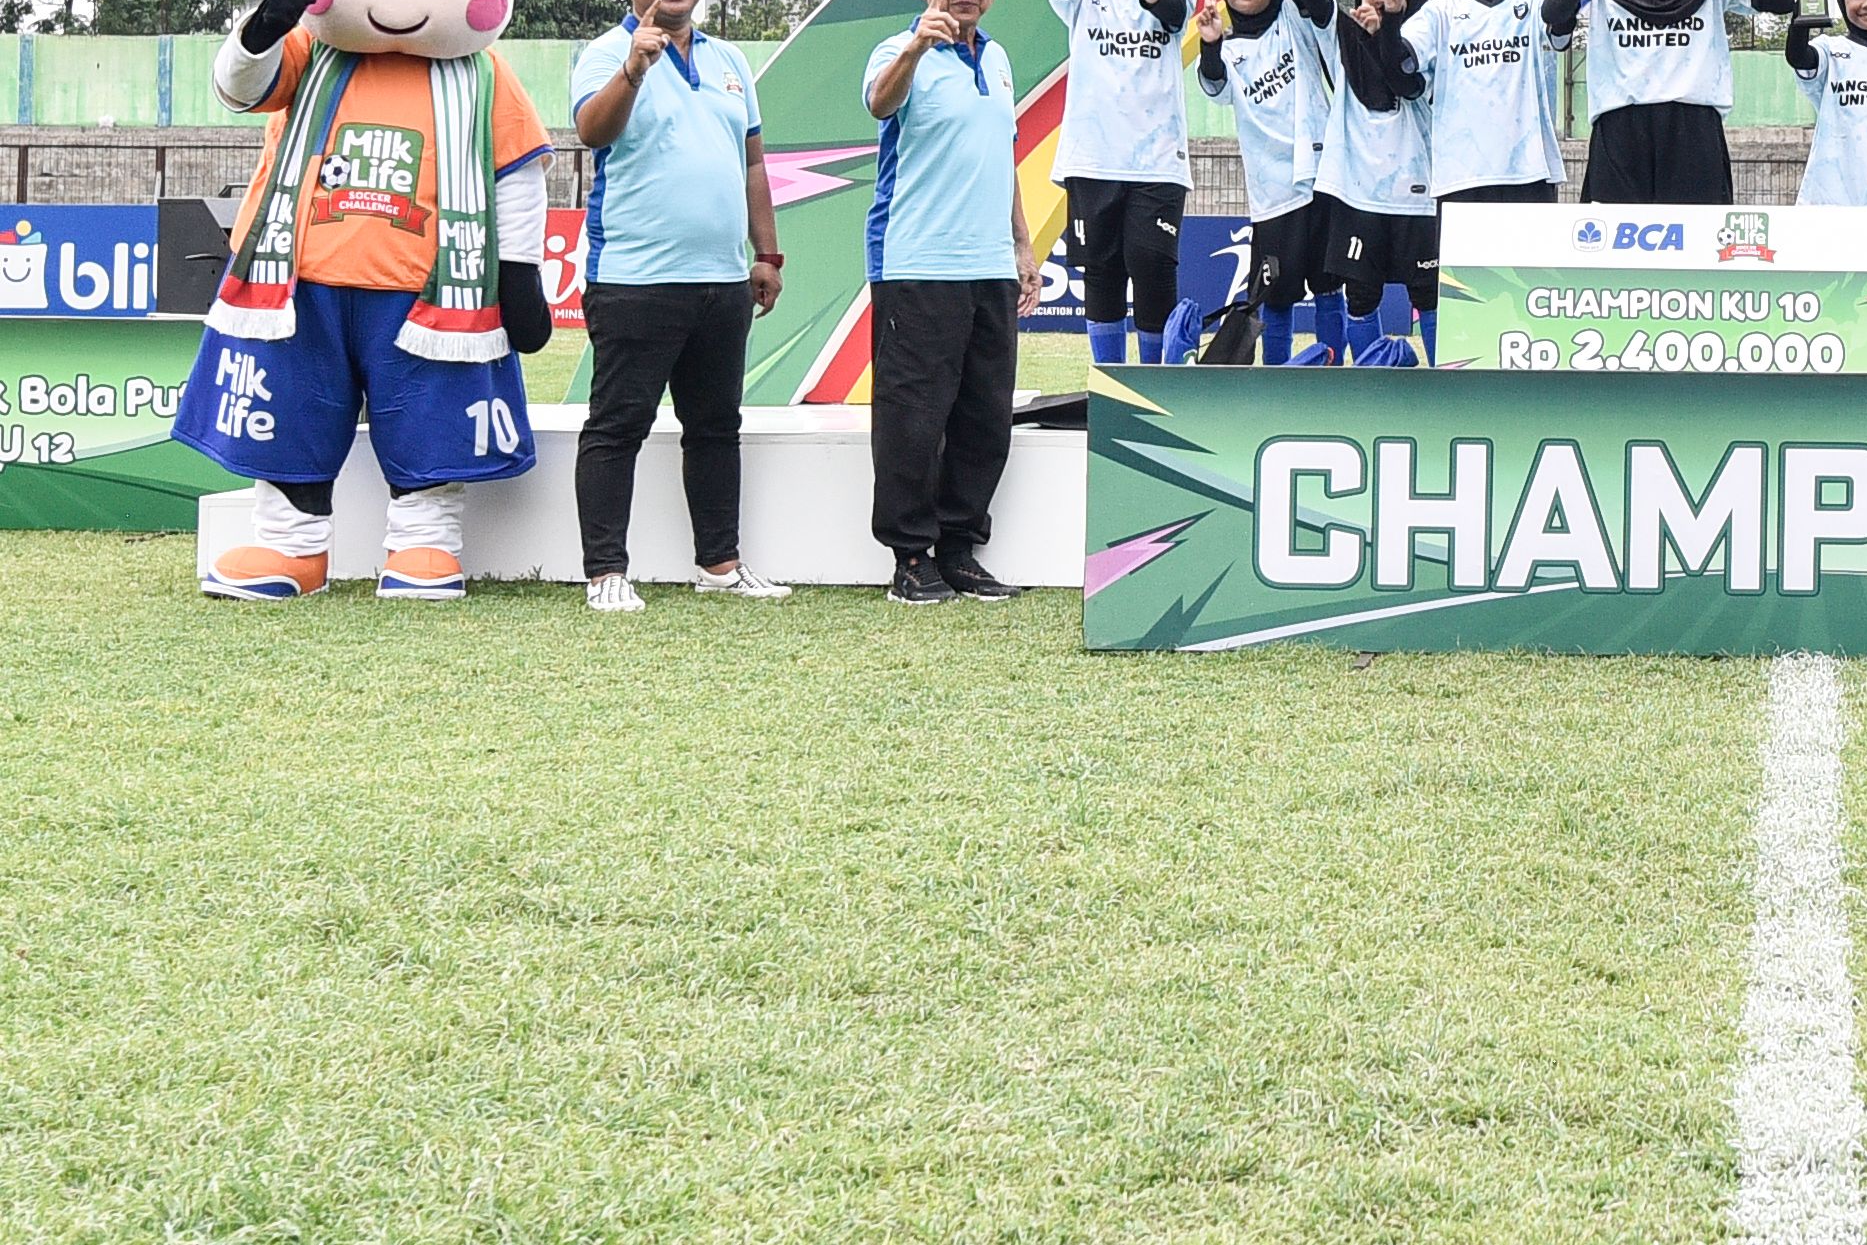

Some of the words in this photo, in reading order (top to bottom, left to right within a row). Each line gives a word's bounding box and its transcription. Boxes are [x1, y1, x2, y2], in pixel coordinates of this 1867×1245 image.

[1099, 42, 1162, 59] UNITED
[1450, 35, 1530, 57] VANGUARD
[1618, 32, 1691, 49] UNITED
[1242, 48, 1295, 98] VANGUAR
[1463, 50, 1521, 69] UNITED
[342, 129, 412, 164] Milk
[350, 158, 413, 193] Life
[266, 191, 293, 225] lk
[338, 199, 400, 216] CHALLENGE
[348, 190, 391, 204] SOCCER
[1073, 218, 1086, 246] 4
[1611, 222, 1684, 251] BCA
[1729, 213, 1766, 231] Milk
[1734, 227, 1767, 245] Life
[59, 242, 158, 311] bli
[554, 308, 585, 320] MINE
[1526, 286, 1714, 321] CHAMPION
[1720, 289, 1771, 322] KU
[1777, 291, 1821, 322] 10
[1569, 328, 1846, 373] 2.400.000
[215, 347, 273, 402] Milk
[19, 373, 117, 417] Bola
[215, 391, 275, 442] Life
[465, 397, 520, 457] 10
[0, 424, 24, 465] U
[31, 431, 76, 465] 12
